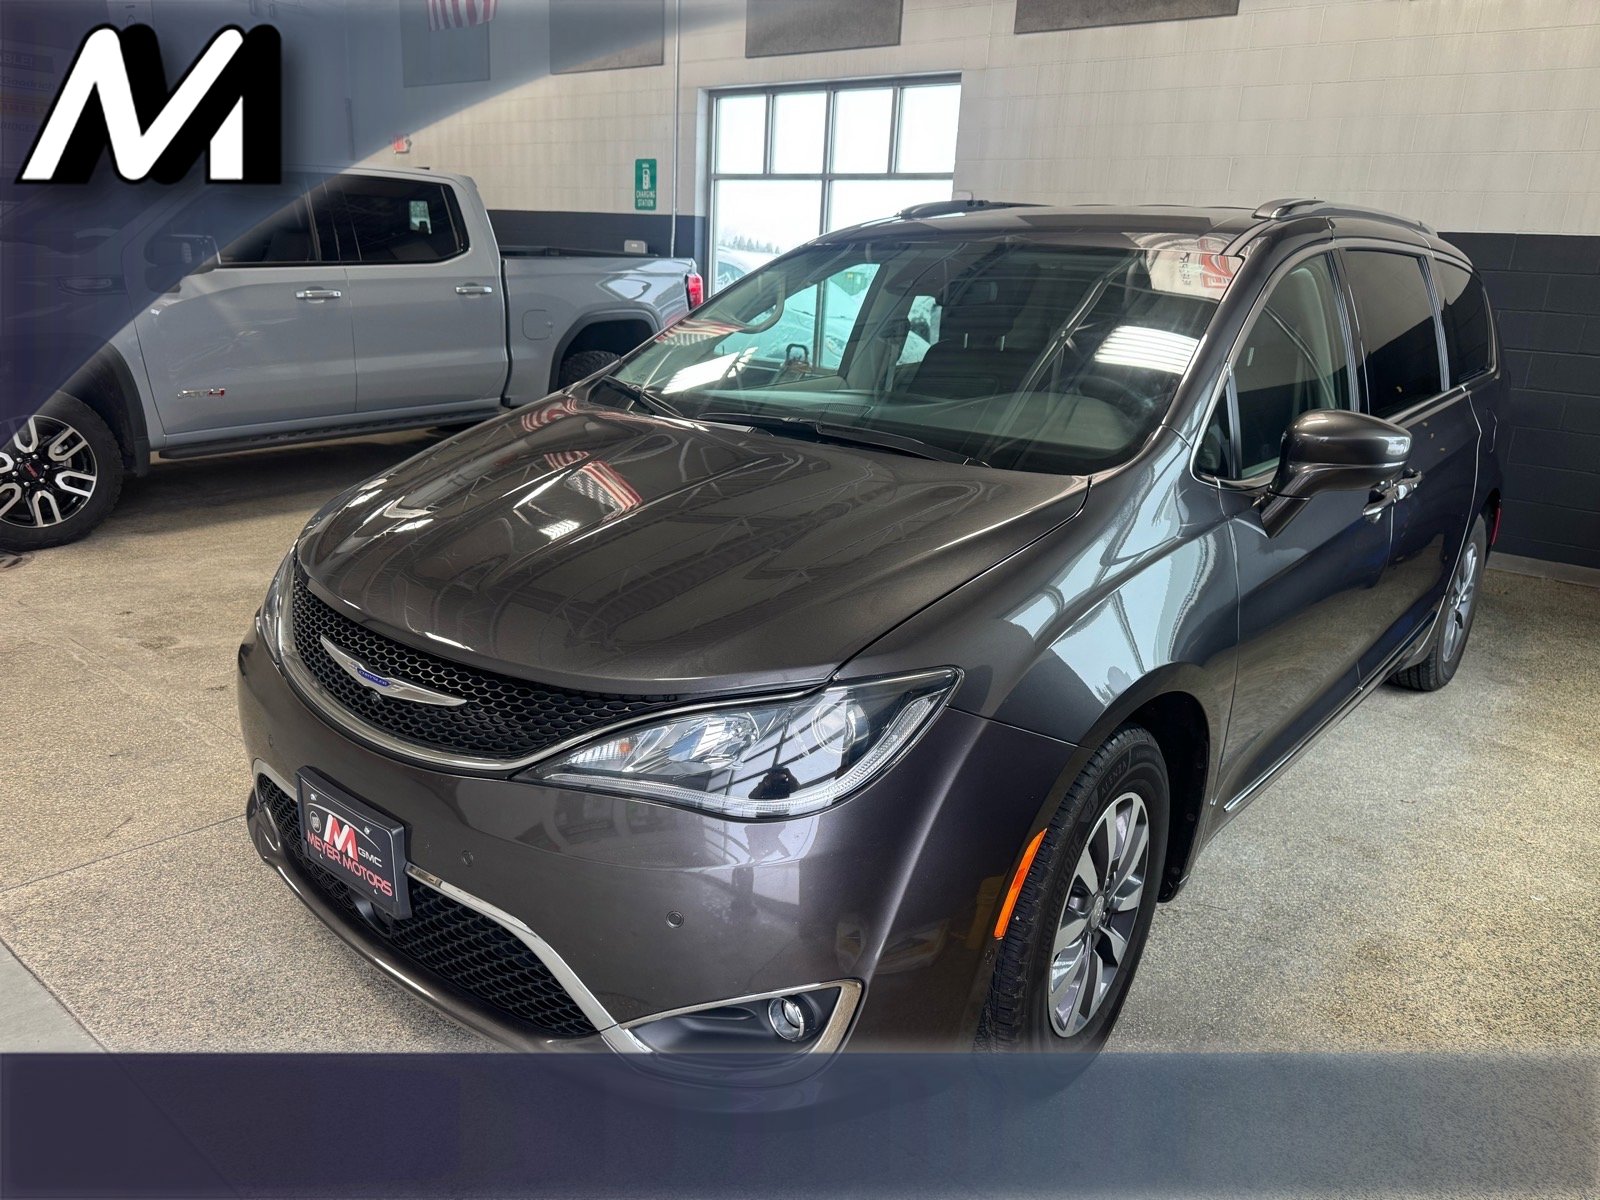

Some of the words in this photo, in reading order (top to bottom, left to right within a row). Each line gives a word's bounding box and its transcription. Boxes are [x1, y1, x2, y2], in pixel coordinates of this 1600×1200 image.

[636, 190, 656, 199] CHARGING
[637, 199, 654, 207] STATION
[307, 829, 341, 864] MEYER
[343, 857, 393, 897] MOTORS
[358, 846, 383, 868] GMC
